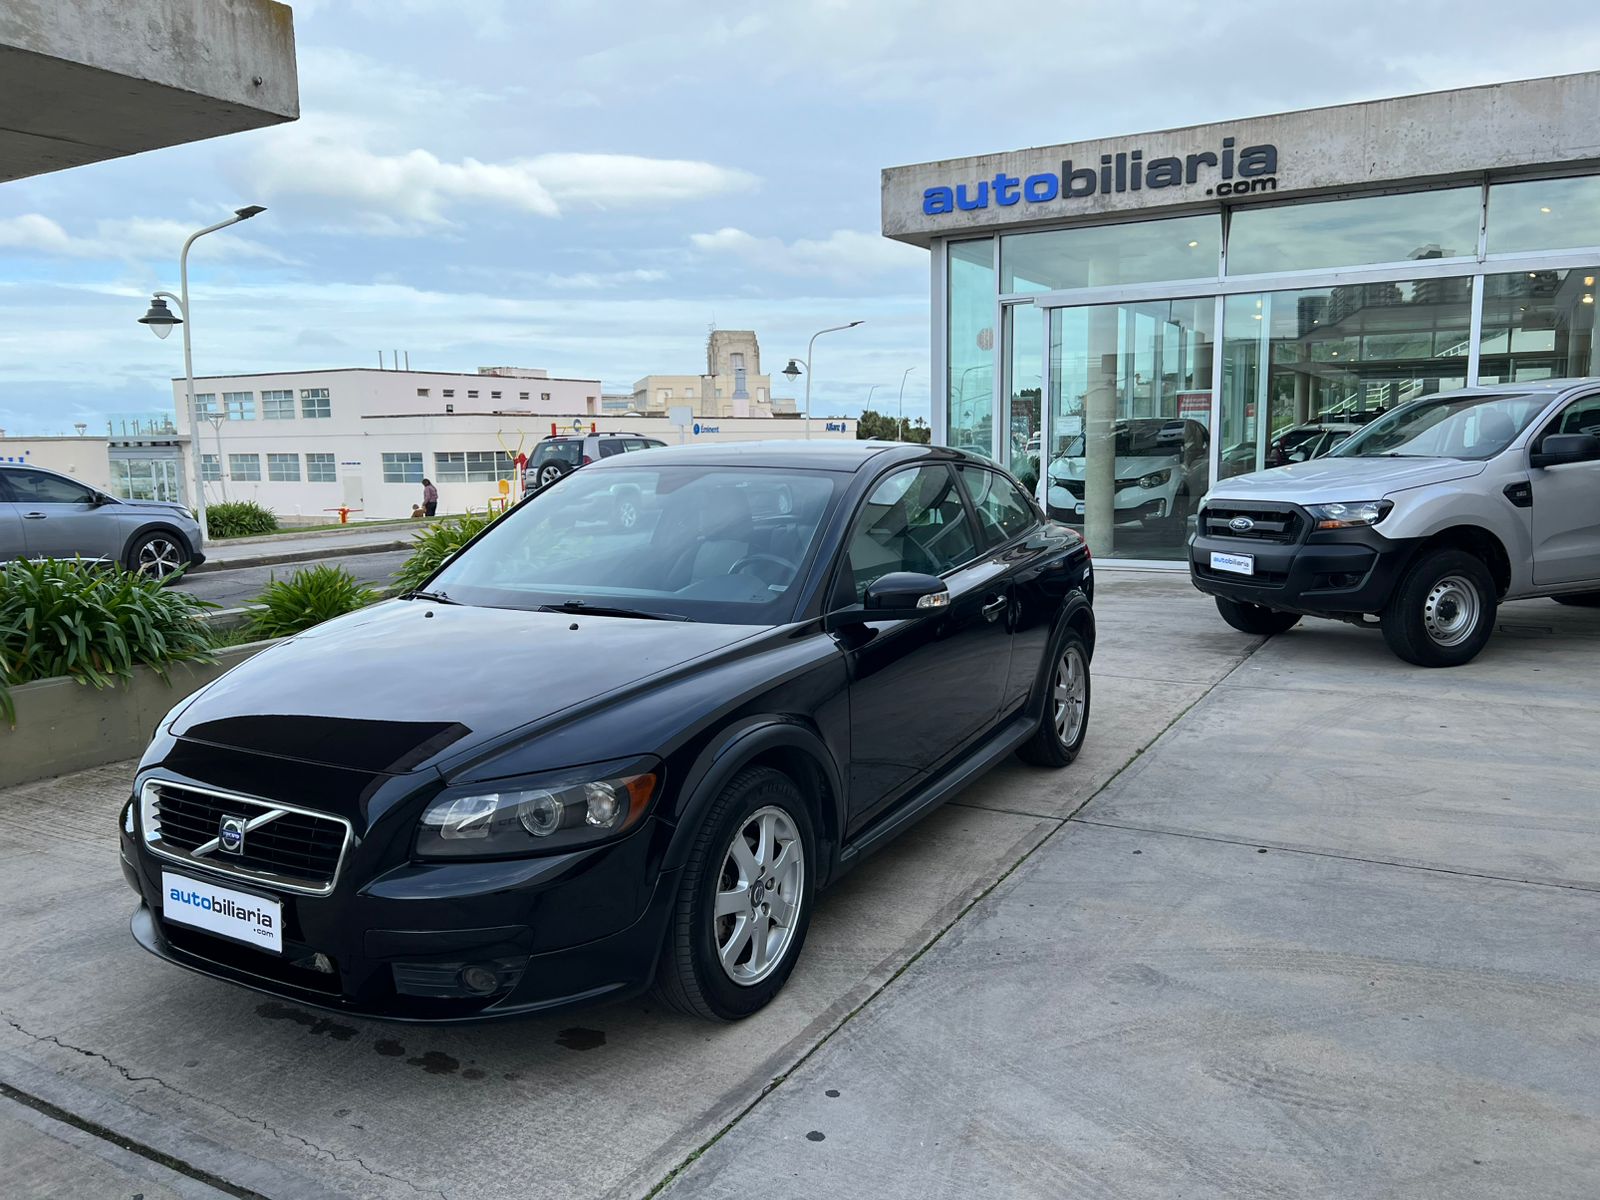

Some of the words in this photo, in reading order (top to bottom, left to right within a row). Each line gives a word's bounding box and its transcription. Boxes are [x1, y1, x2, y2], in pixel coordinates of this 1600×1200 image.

[922, 136, 1278, 216] autobiliaria
[1206, 176, 1278, 197] .com
[170, 888, 273, 928] autobiliaria
[253, 928, 274, 938] .com
